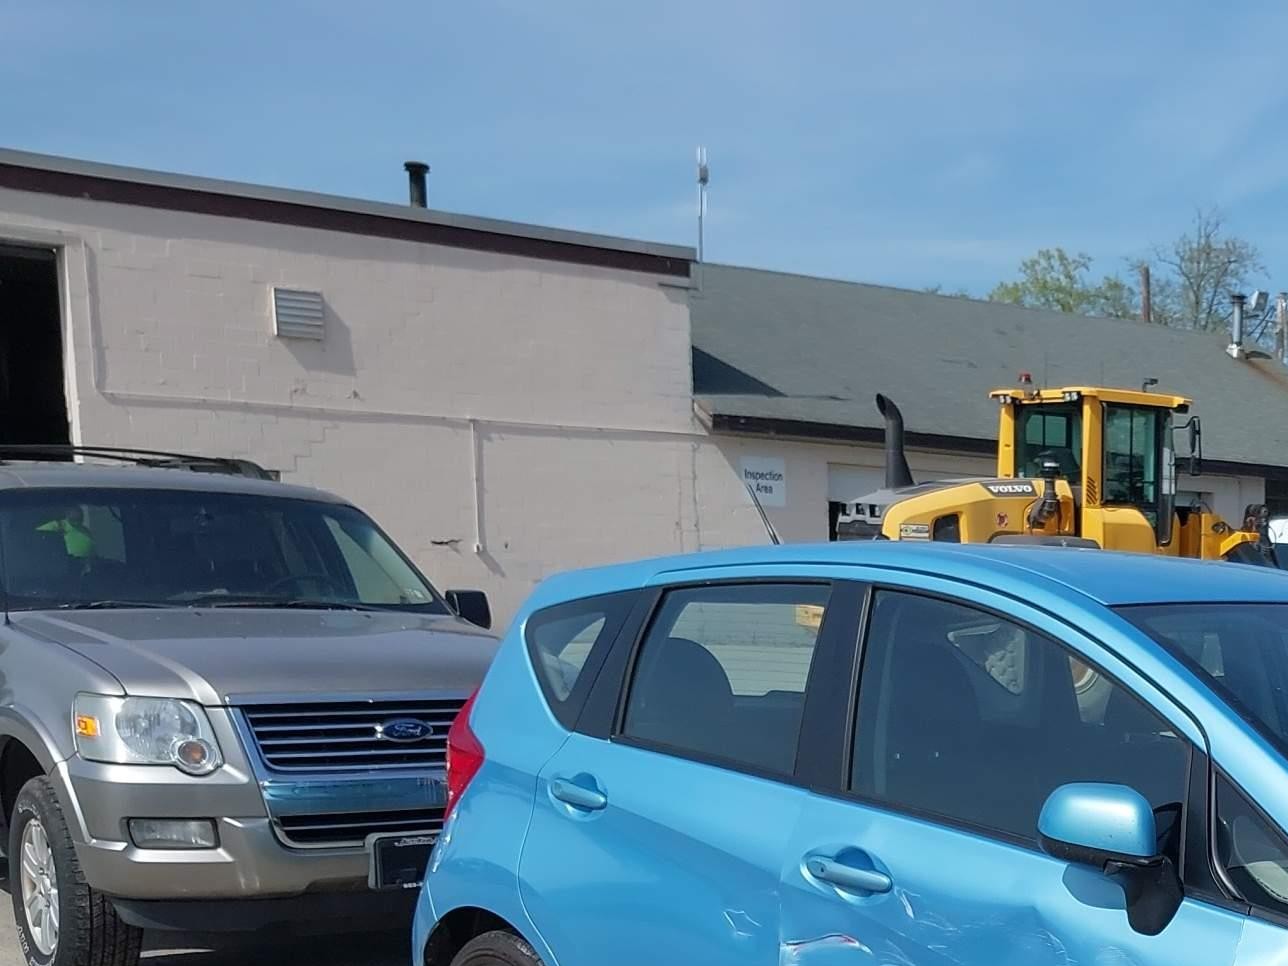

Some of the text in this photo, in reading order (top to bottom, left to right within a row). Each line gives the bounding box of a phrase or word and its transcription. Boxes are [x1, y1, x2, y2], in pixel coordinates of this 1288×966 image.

[744, 468, 784, 482] Inspection
[755, 483, 774, 495] Area
[988, 484, 1033, 494] VOLVO
